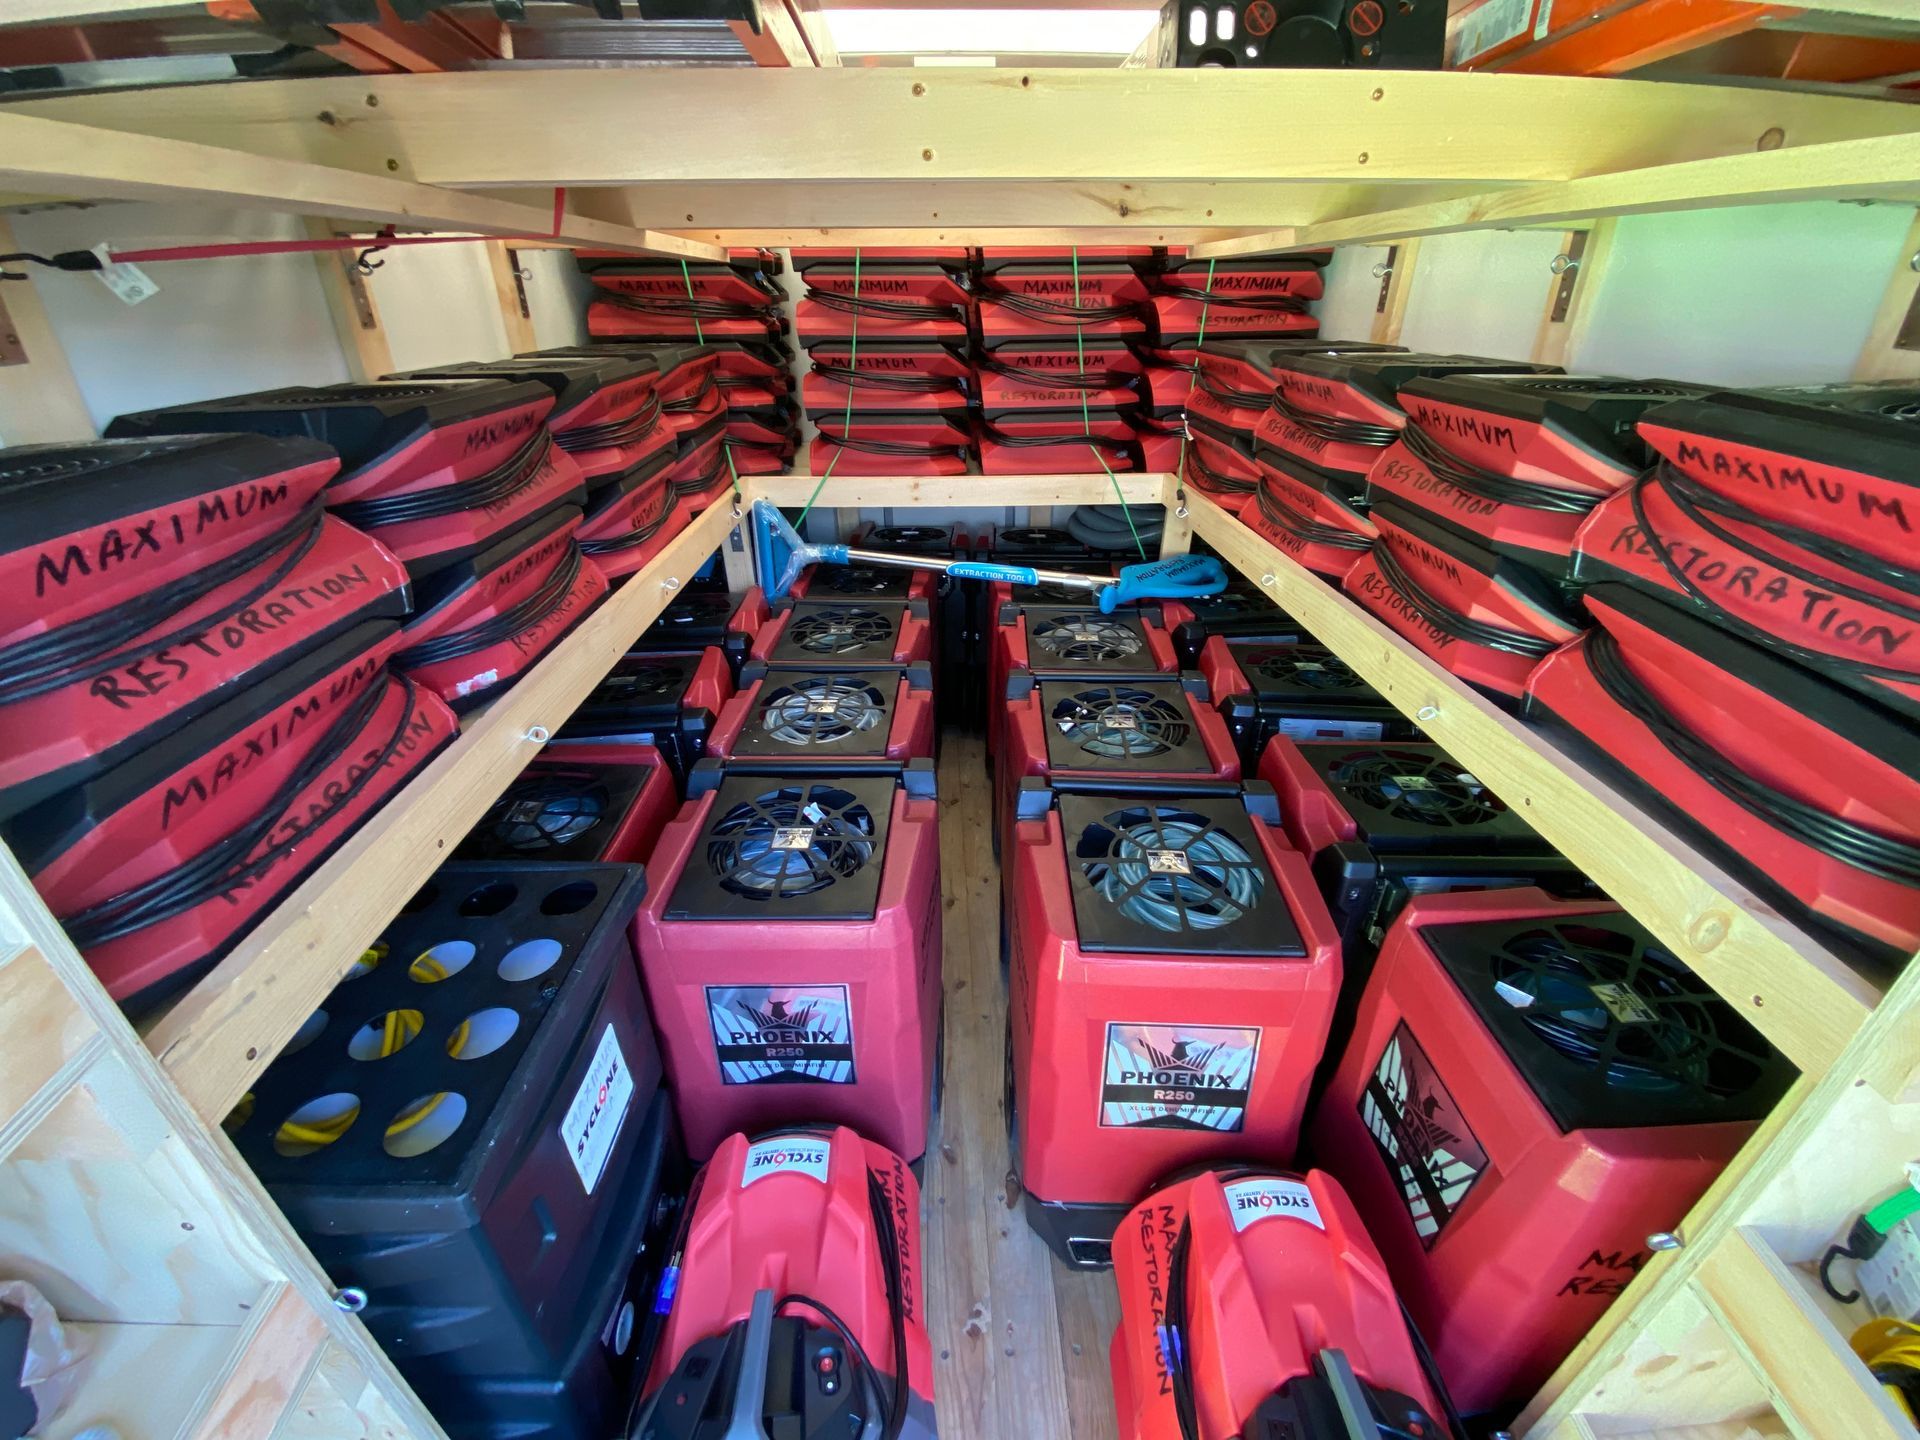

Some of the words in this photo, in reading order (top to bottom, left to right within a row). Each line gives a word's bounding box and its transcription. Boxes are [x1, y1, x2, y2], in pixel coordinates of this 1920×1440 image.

[833, 280, 908, 292] MAXIMUM
[1023, 280, 1102, 296] MAXIMUM
[1211, 276, 1290, 292] MAXIMUM
[830, 357, 917, 369] MAXIMUM
[1016, 355, 1105, 367] MAXIMUM
[1266, 418, 1329, 454] RESTORATION
[1416, 403, 1517, 454] MAXIMUM
[1383, 460, 1503, 516] RESTORATION
[1677, 440, 1912, 534] MAXIMUM
[35, 479, 289, 598] MAXIMUM
[954, 567, 1003, 580] EXTRACTION
[1005, 573, 1025, 582] TOOL
[1384, 528, 1464, 586] MAXIMUM
[1610, 524, 1912, 655] RESTORATION
[1361, 571, 1456, 649] RESTORATION
[90, 563, 370, 710] RESTORATION
[161, 657, 377, 831] MAXIMUM
[730, 1030, 836, 1044] PHOENIX
[765, 1047, 805, 1057] R250
[1120, 1070, 1233, 1088] PHOENIX
[1153, 1089, 1196, 1101] R250
[577, 1055, 619, 1159] SYCLONE
[1384, 1075, 1450, 1194] PHOENIX
[752, 1151, 824, 1168] SYCLONE
[1237, 1194, 1310, 1211] SYCLONE
[891, 1155, 915, 1323] RESTORATION
